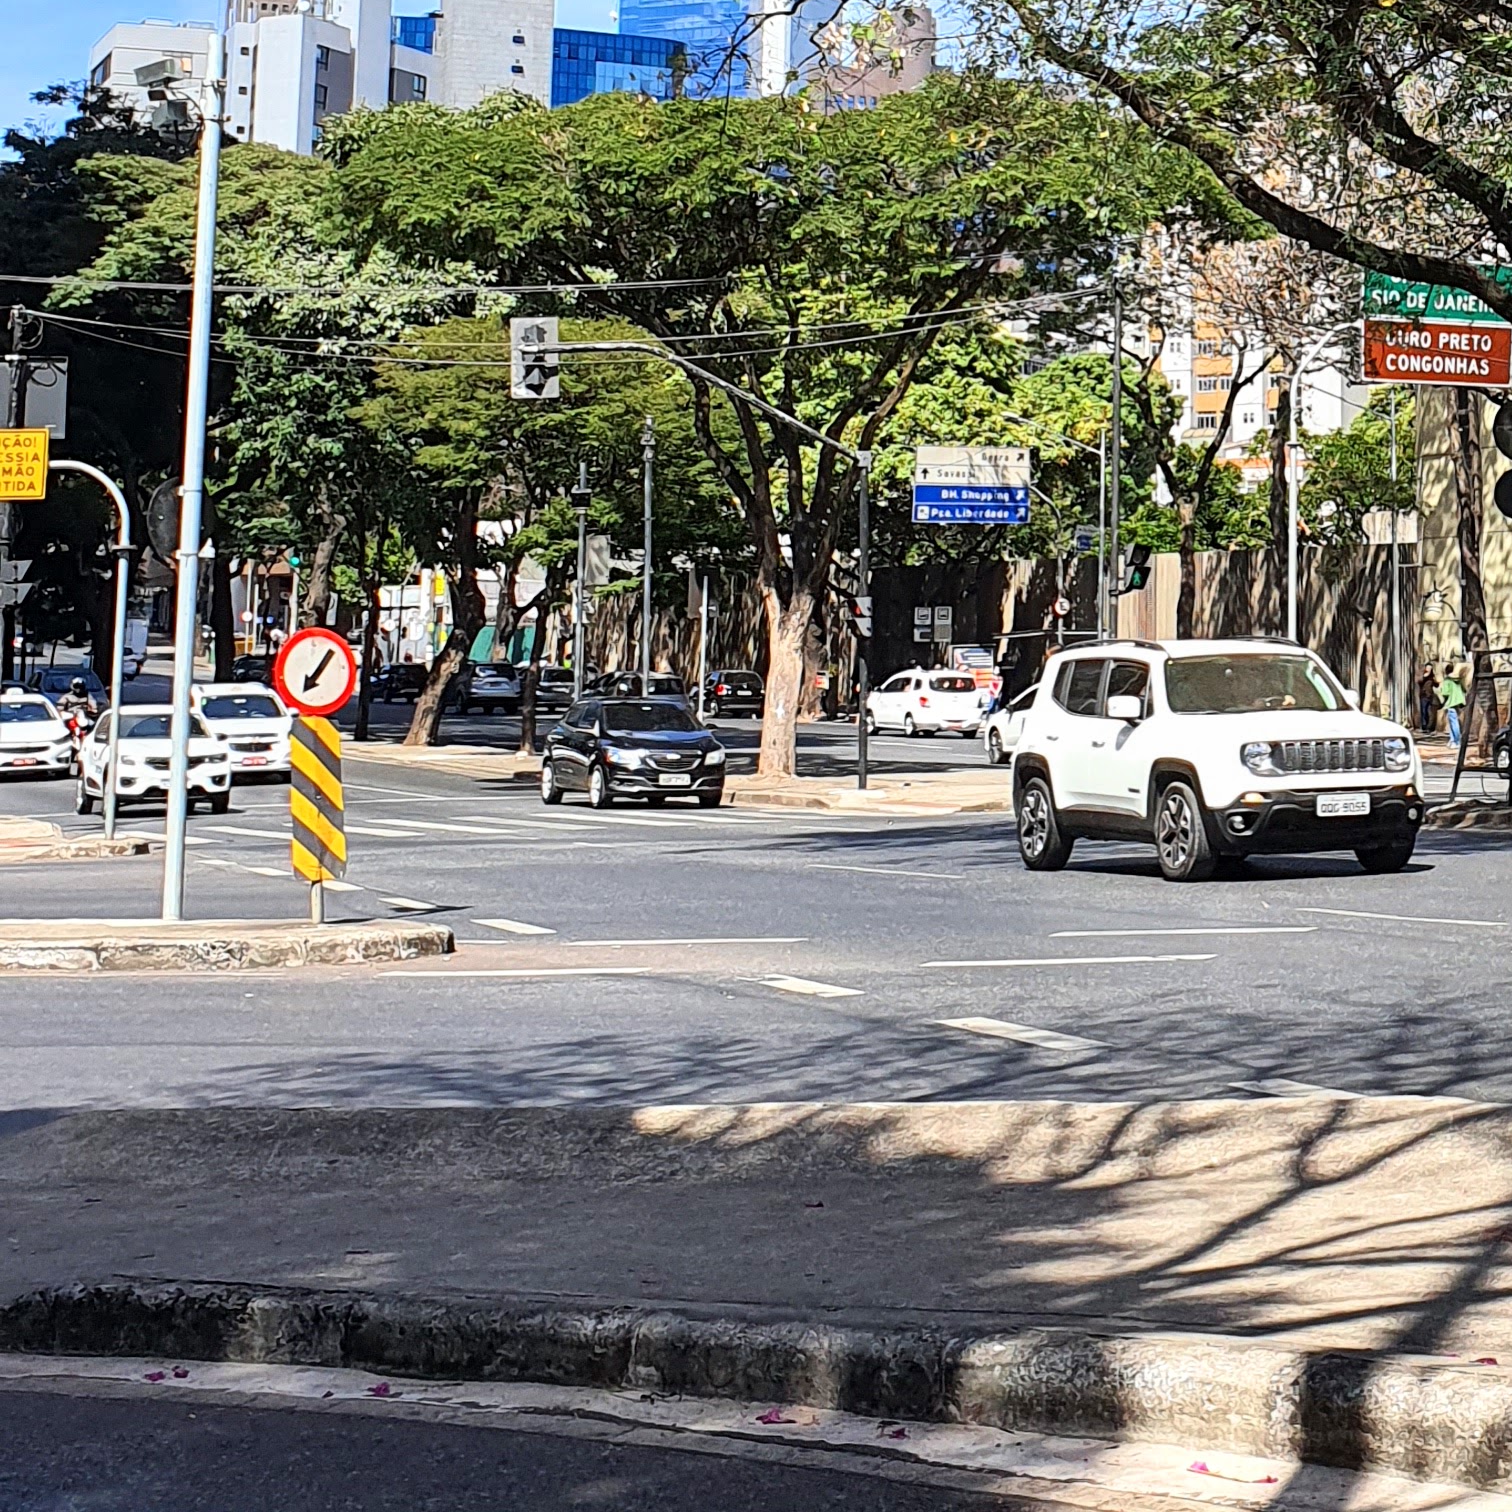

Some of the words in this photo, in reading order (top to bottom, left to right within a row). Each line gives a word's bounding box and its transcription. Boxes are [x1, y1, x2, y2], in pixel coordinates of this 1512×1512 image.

[1406, 292, 1427, 309] DE
[1438, 333, 1492, 352] PRETO
[1385, 354, 1490, 375] CONGONHAS
[0, 434, 37, 450] ÇÃO!
[2, 463, 35, 477] MÃO
[0, 481, 36, 492] TIDA
[961, 489, 1010, 502] Shopping
